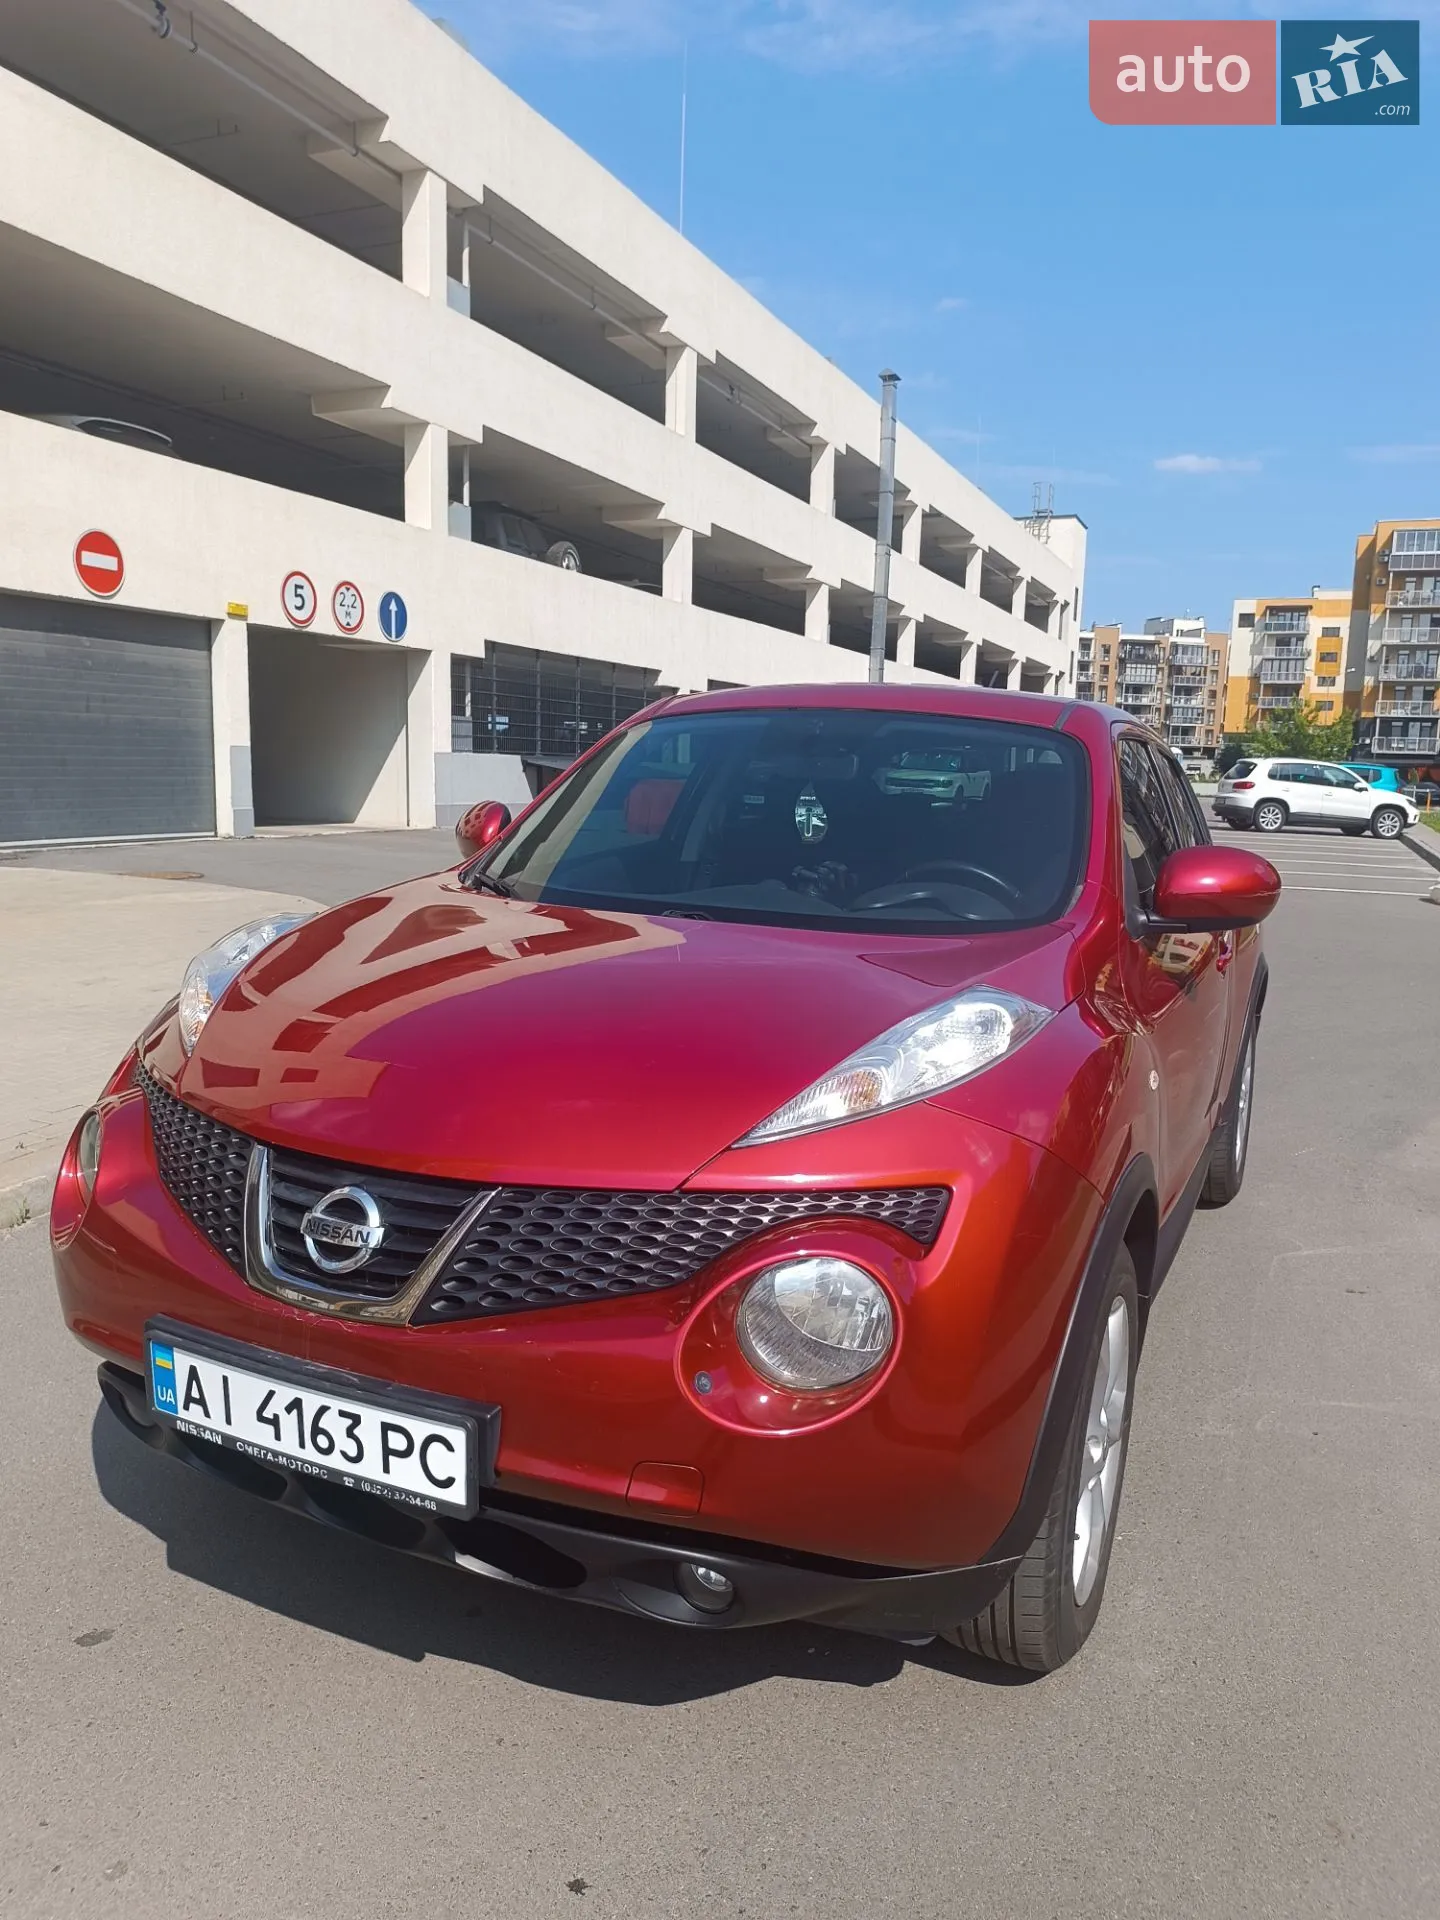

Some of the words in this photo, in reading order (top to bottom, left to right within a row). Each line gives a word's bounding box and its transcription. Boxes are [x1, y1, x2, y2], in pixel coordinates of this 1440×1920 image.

[294, 584, 305, 611] 5
[305, 1219, 371, 1244] NISSAN
[157, 1384, 176, 1405] UA
[176, 1420, 222, 1445] NISSAN
[182, 1364, 232, 1426] AI
[256, 1389, 365, 1464] 4163
[380, 1421, 456, 1489] PC
